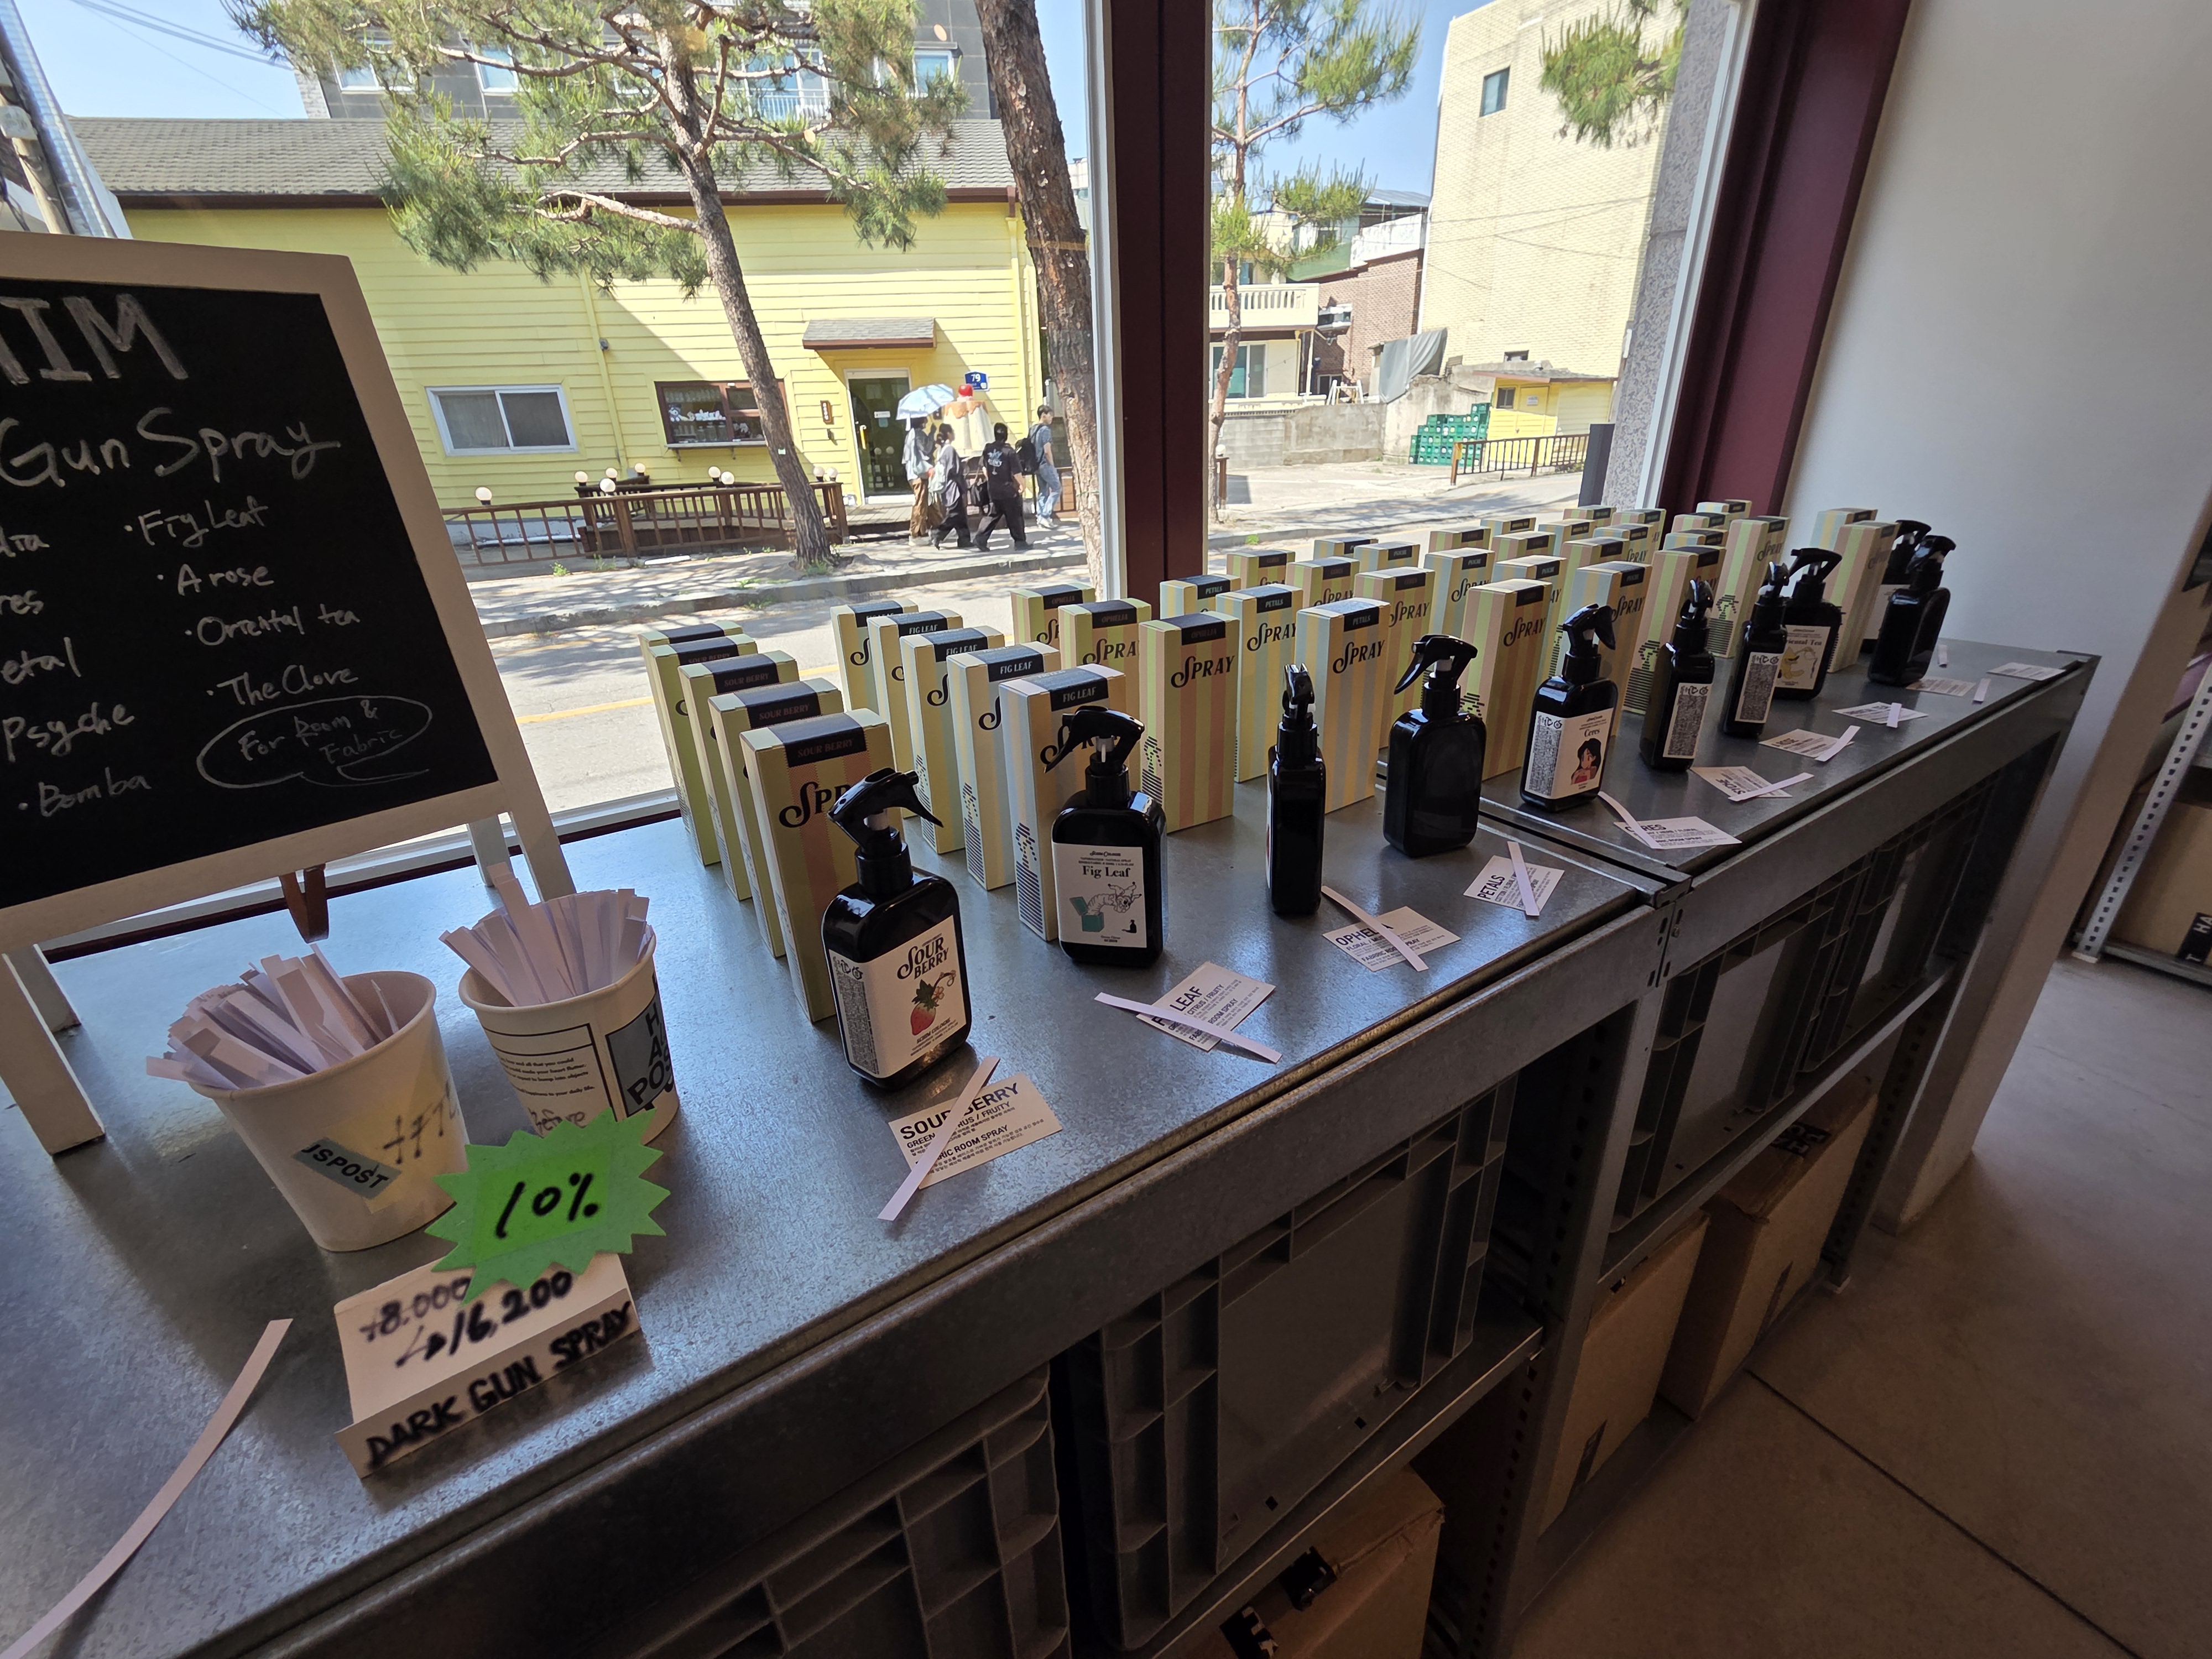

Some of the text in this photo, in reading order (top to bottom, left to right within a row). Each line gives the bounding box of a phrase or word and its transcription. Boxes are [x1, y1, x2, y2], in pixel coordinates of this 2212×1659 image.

[971, 373, 981, 382] 79
[137, 407, 341, 481] Spray
[909, 624, 938, 635] FIG LEAF
[1503, 617, 1546, 647] SPRAY
[946, 644, 978, 656] FIG LEAF
[1083, 639, 1136, 665] SPRA
[1333, 640, 1385, 674] SPRAY
[724, 672, 770, 687] SOUR BERRY
[1000, 661, 1033, 675] FIG LEAF
[1171, 655, 1235, 688] SPRAY
[217, 673, 281, 707] The
[1062, 686, 1097, 703] FIG LEAF
[759, 703, 810, 721] SOUR BERRY
[3, 702, 136, 762] Psyche
[240, 729, 286, 761] For
[361, 699, 378, 719] &
[324, 729, 404, 765] Fabric
[797, 738, 854, 758] SOUR BERRY
[39, 768, 152, 818] Bomba
[1625, 824, 1666, 834] CRES
[1082, 865, 1131, 879] Fig Leaf
[1477, 874, 1505, 900] PETALS
[1335, 923, 1394, 946] OPHEL
[897, 937, 944, 980] SOUR
[914, 947, 950, 980] BERRY
[1170, 986, 1202, 1011] LEAF
[1208, 1010, 1224, 1024] ROOM
[1222, 998, 1238, 1013] SPRAY
[907, 1132, 936, 1149] GREEN
[982, 1100, 1011, 1117] FRUITY
[954, 1138, 981, 1153] ROOM
[980, 1124, 1009, 1141] SPRAY
[301, 1144, 389, 1188] JSPOST
[495, 1173, 599, 1239] 10%
[366, 1301, 632, 1469] DARK GUN SPRAY
